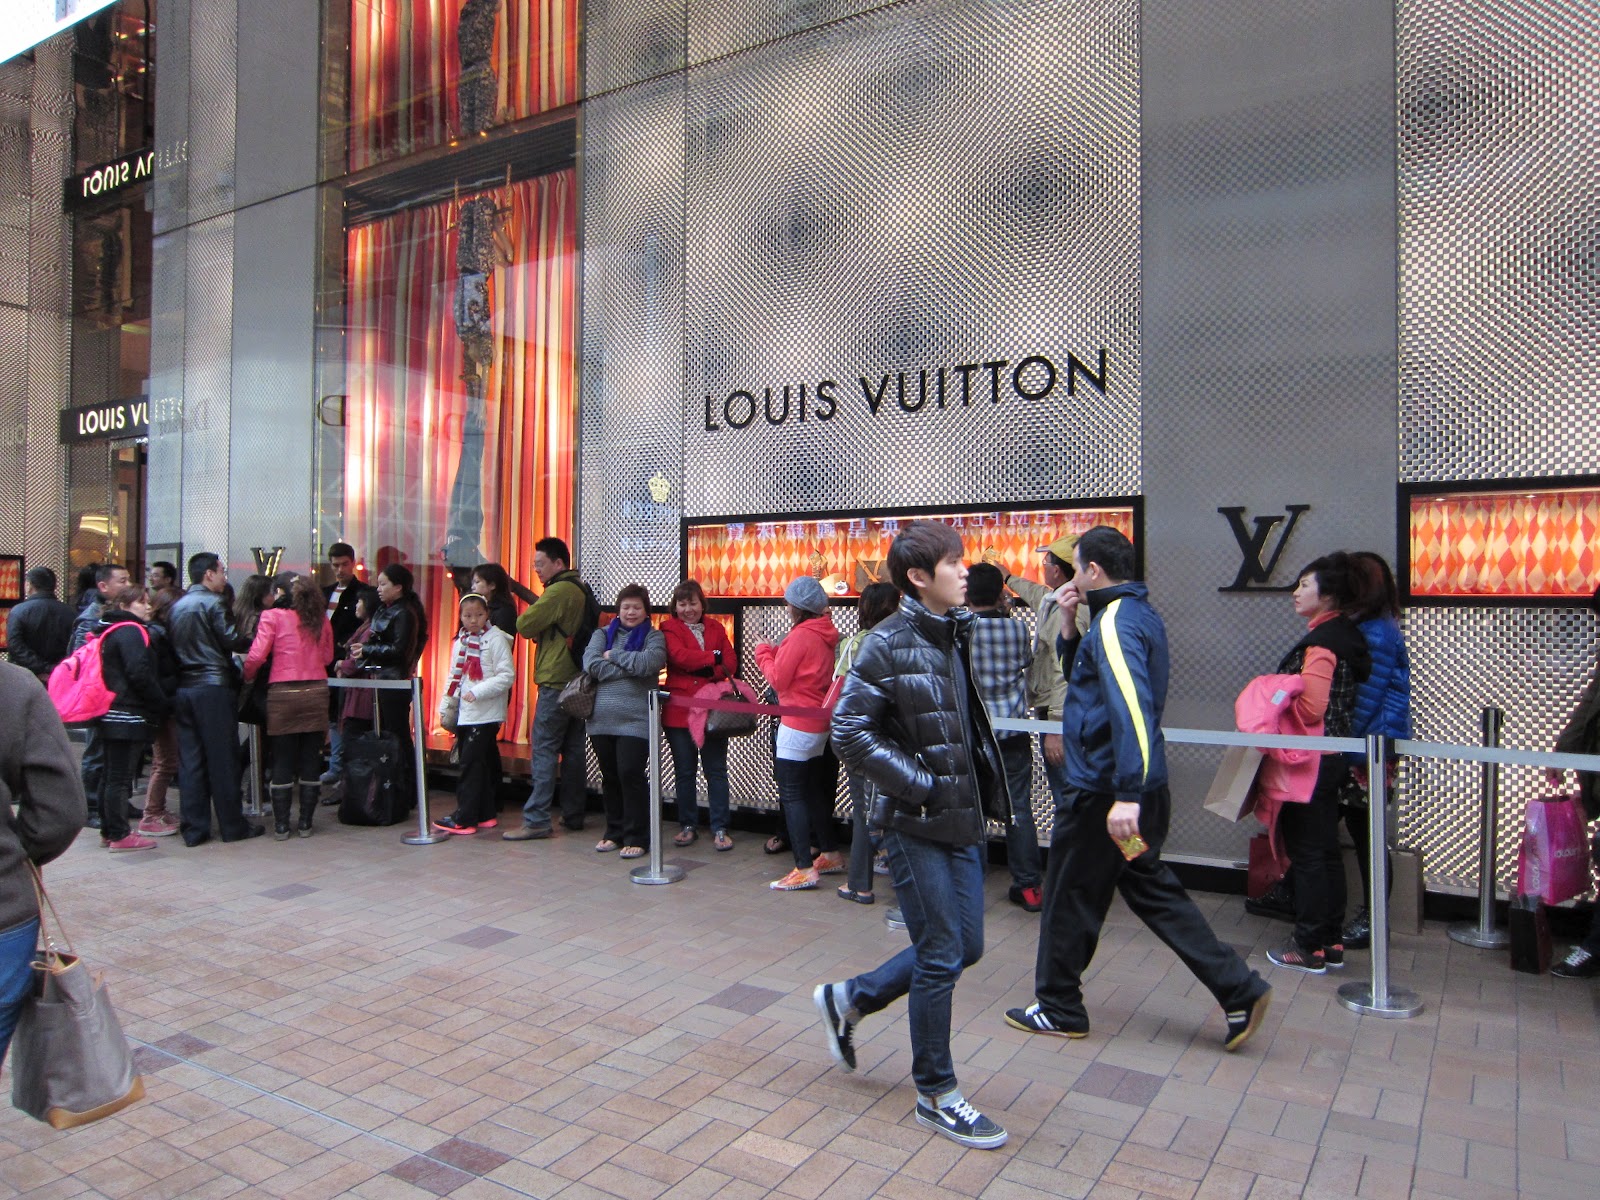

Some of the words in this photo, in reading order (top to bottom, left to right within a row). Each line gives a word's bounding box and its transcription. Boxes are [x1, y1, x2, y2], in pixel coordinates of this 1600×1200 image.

[79, 405, 125, 435] LOUIS
[706, 380, 837, 431] LOUIS
[859, 348, 1107, 417] VUITTON
[1217, 504, 1310, 592] LV
